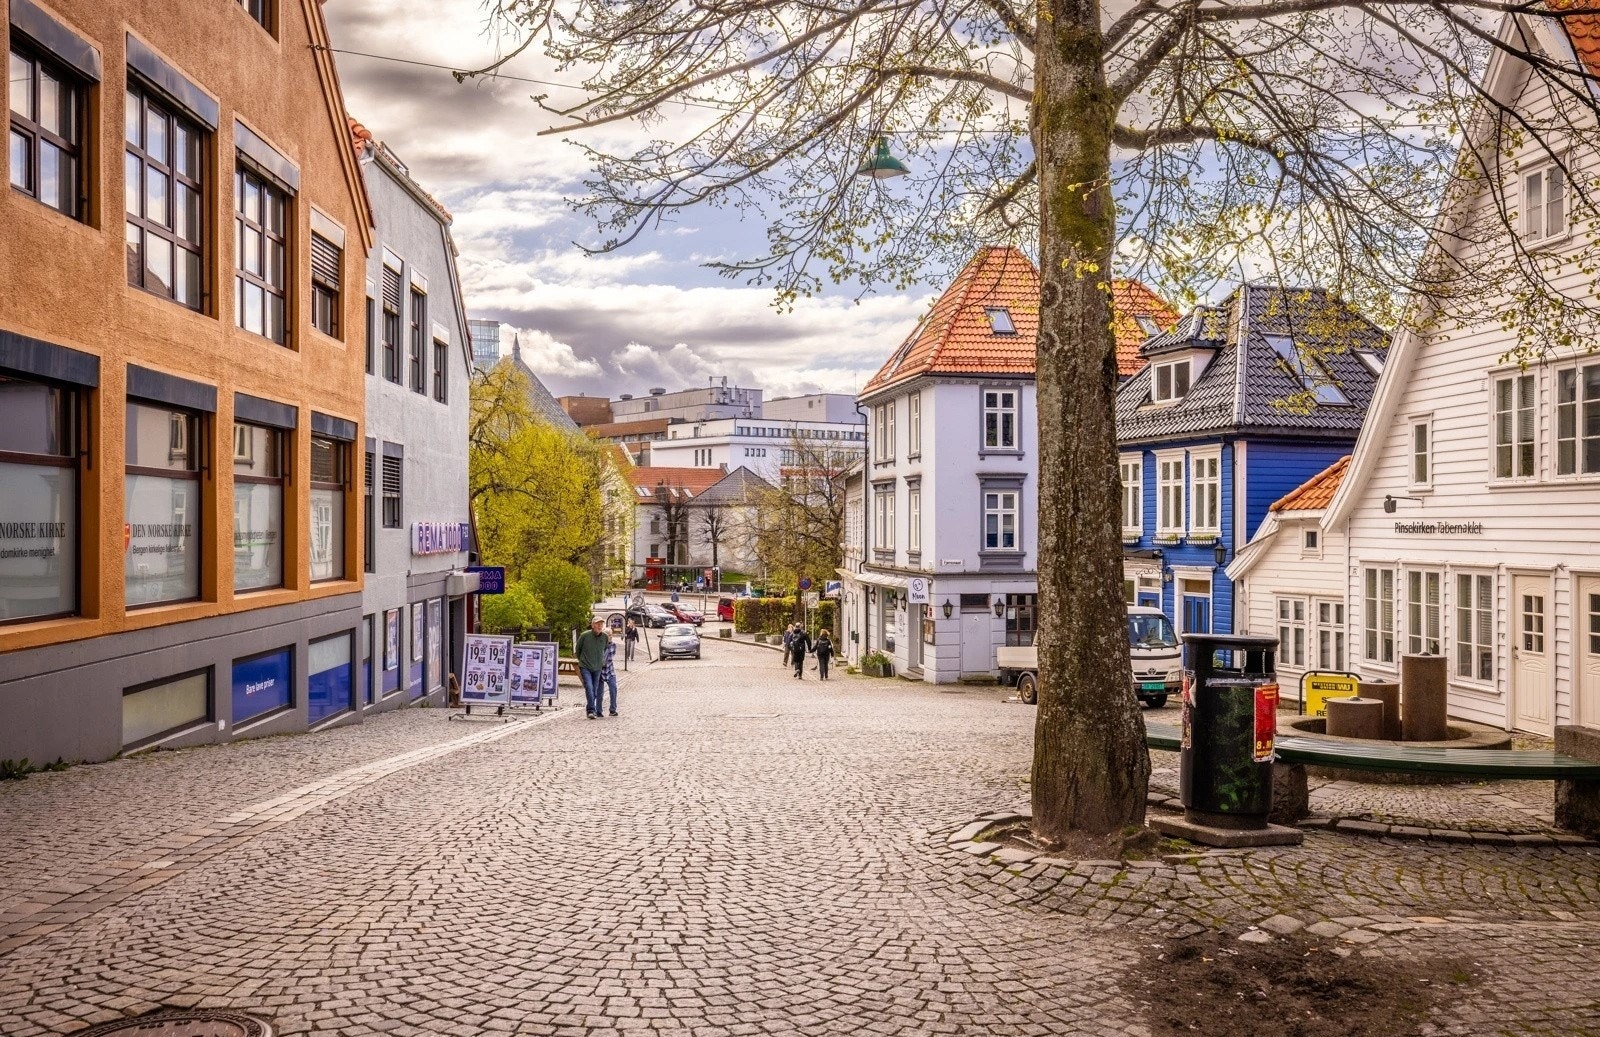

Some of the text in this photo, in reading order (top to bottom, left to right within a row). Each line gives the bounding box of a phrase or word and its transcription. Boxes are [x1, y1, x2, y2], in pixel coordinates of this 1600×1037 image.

[0, 522, 65, 538] NORSKE KIRKE
[132, 523, 192, 538] DEN NORSKE KIRKE
[1394, 521, 1482, 534] Pinsekirken Tabernaklet
[418, 522, 443, 554] REMA
[1, 546, 55, 559] domkirke menighet
[132, 545, 148, 555] Bergen
[477, 570, 502, 580] EMA
[912, 592, 926, 600] Moon
[470, 646, 479, 660] 19
[489, 648, 499, 661] 19
[246, 677, 275, 694] Bare lave priser
[468, 673, 478, 686] 39
[487, 674, 497, 688] 19
